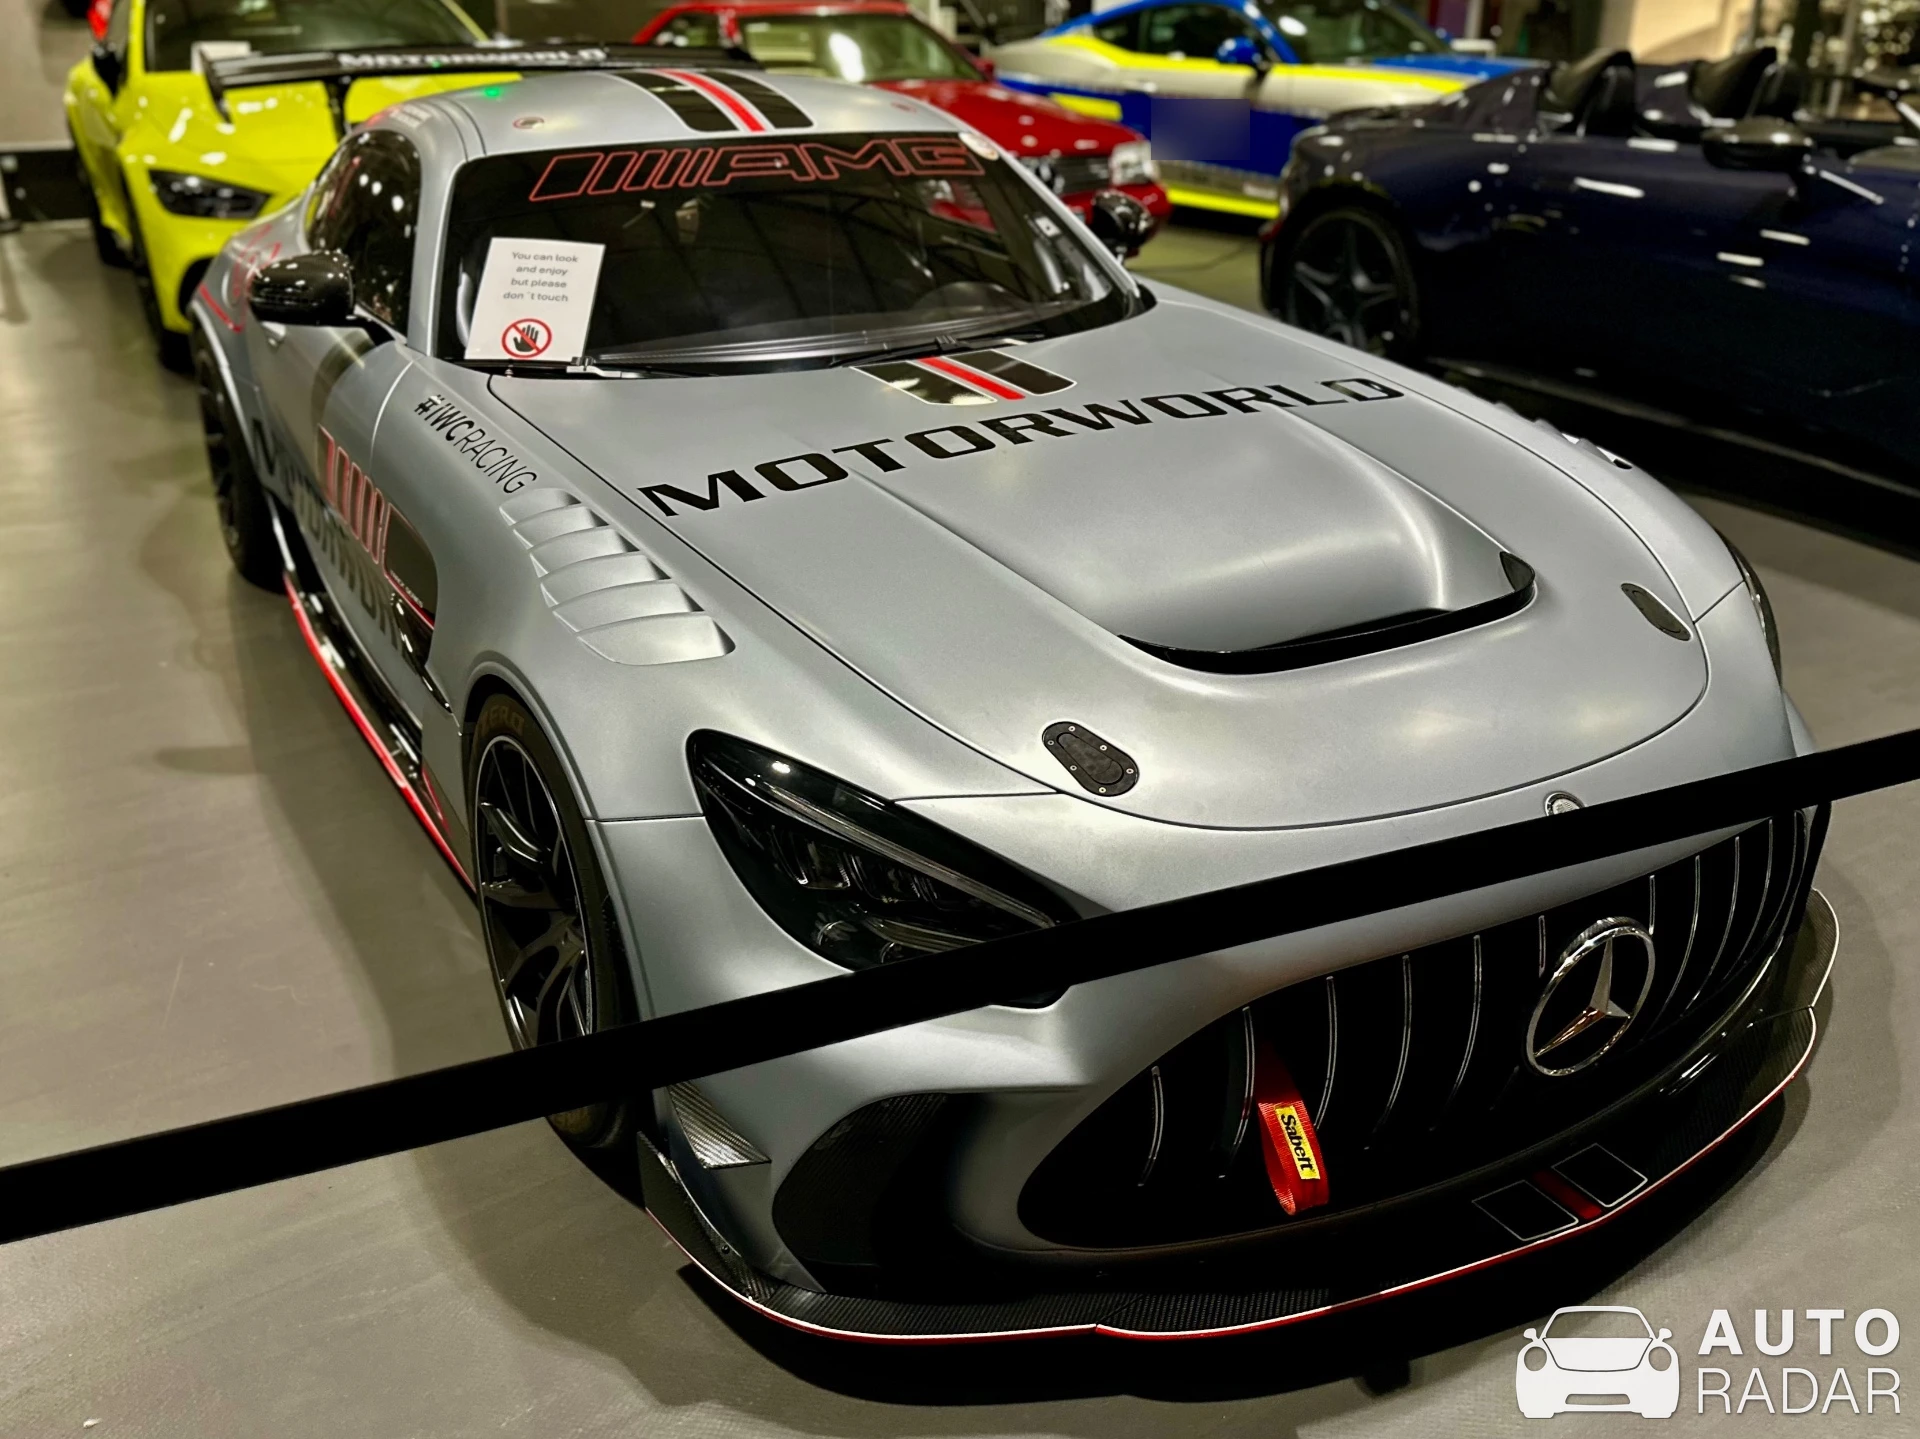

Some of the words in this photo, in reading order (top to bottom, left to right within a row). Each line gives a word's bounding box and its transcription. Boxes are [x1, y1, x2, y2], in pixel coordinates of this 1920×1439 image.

[512, 252, 531, 260] You
[555, 254, 578, 263] look
[516, 265, 537, 273] and
[539, 268, 568, 276] enjoy
[511, 278, 529, 286] but
[531, 279, 567, 288] please
[537, 293, 568, 302] touch
[413, 394, 538, 494] #IWCRACING
[637, 377, 1406, 517] MOTORWORLD
[1280, 1113, 1314, 1172] Sabelt
